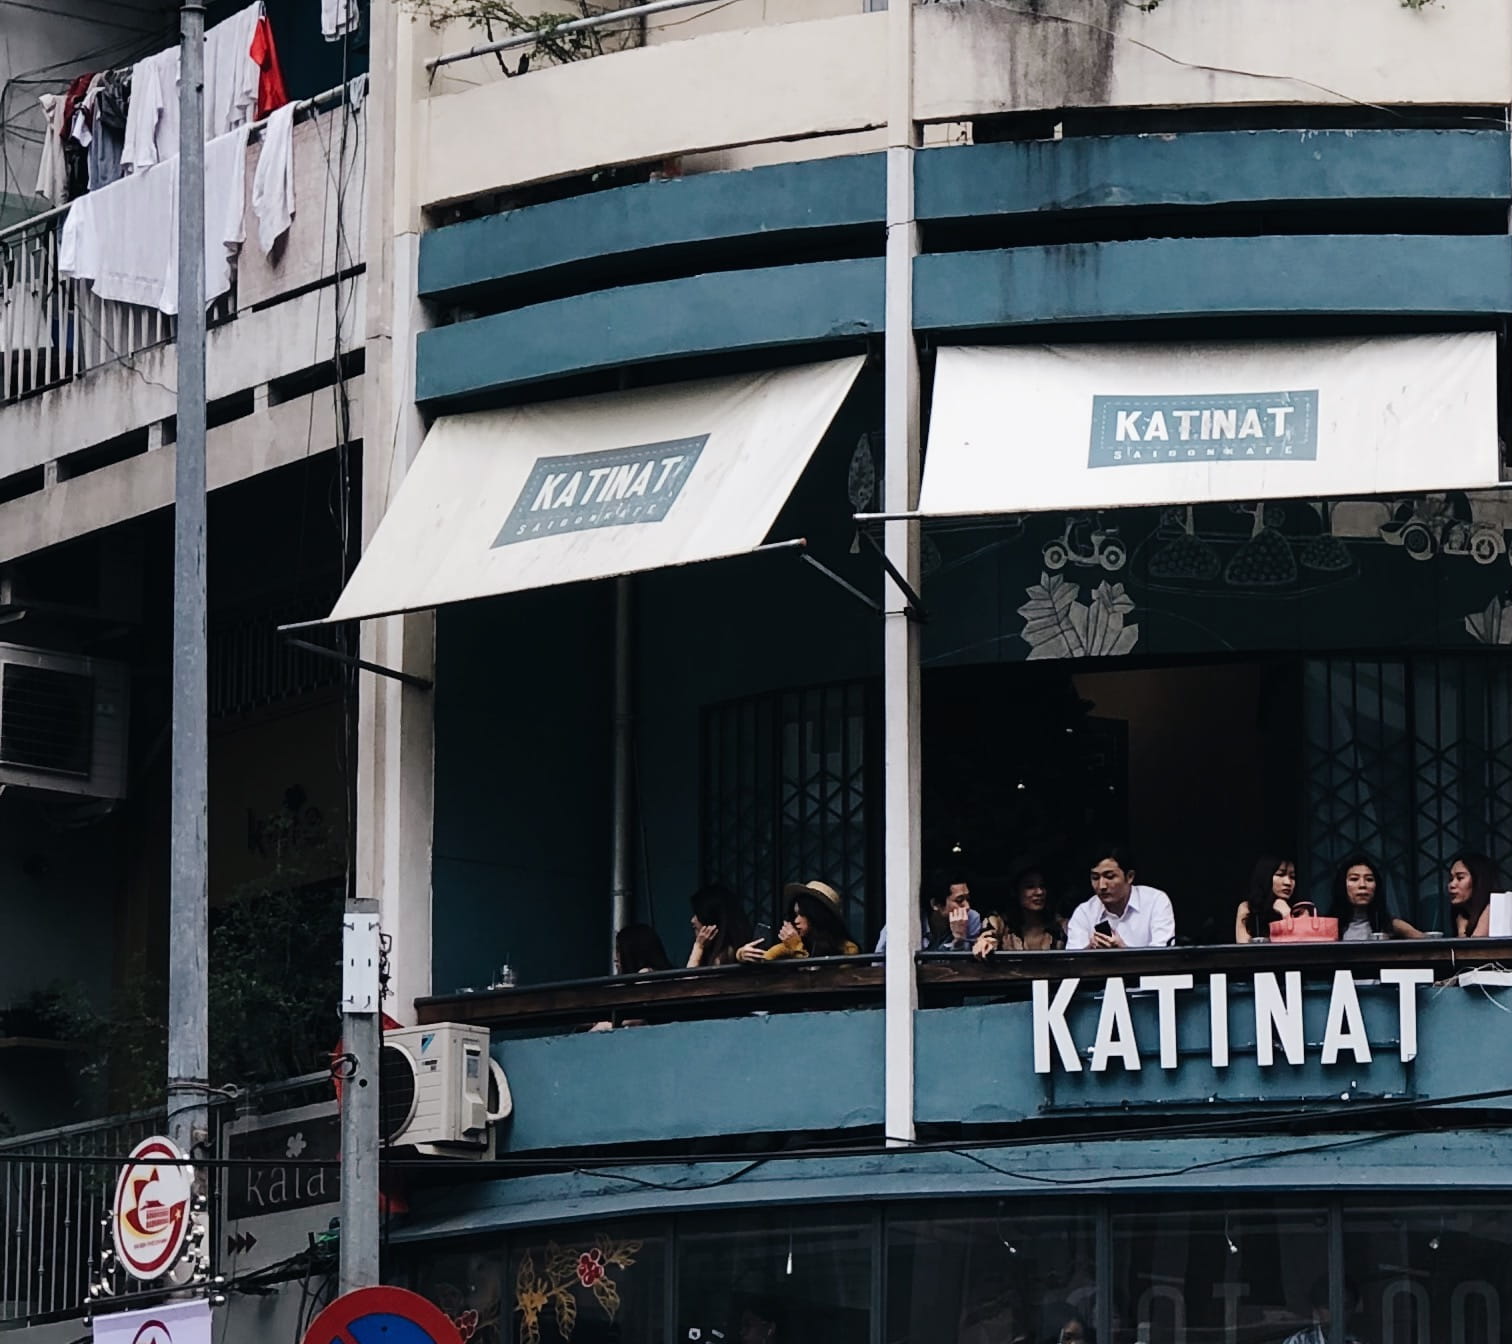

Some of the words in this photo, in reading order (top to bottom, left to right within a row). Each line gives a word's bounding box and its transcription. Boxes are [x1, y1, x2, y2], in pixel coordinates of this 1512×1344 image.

[1115, 406, 1295, 442] KATINAT
[529, 455, 685, 512] KATINAT
[1031, 967, 1435, 1074] KATINAT
